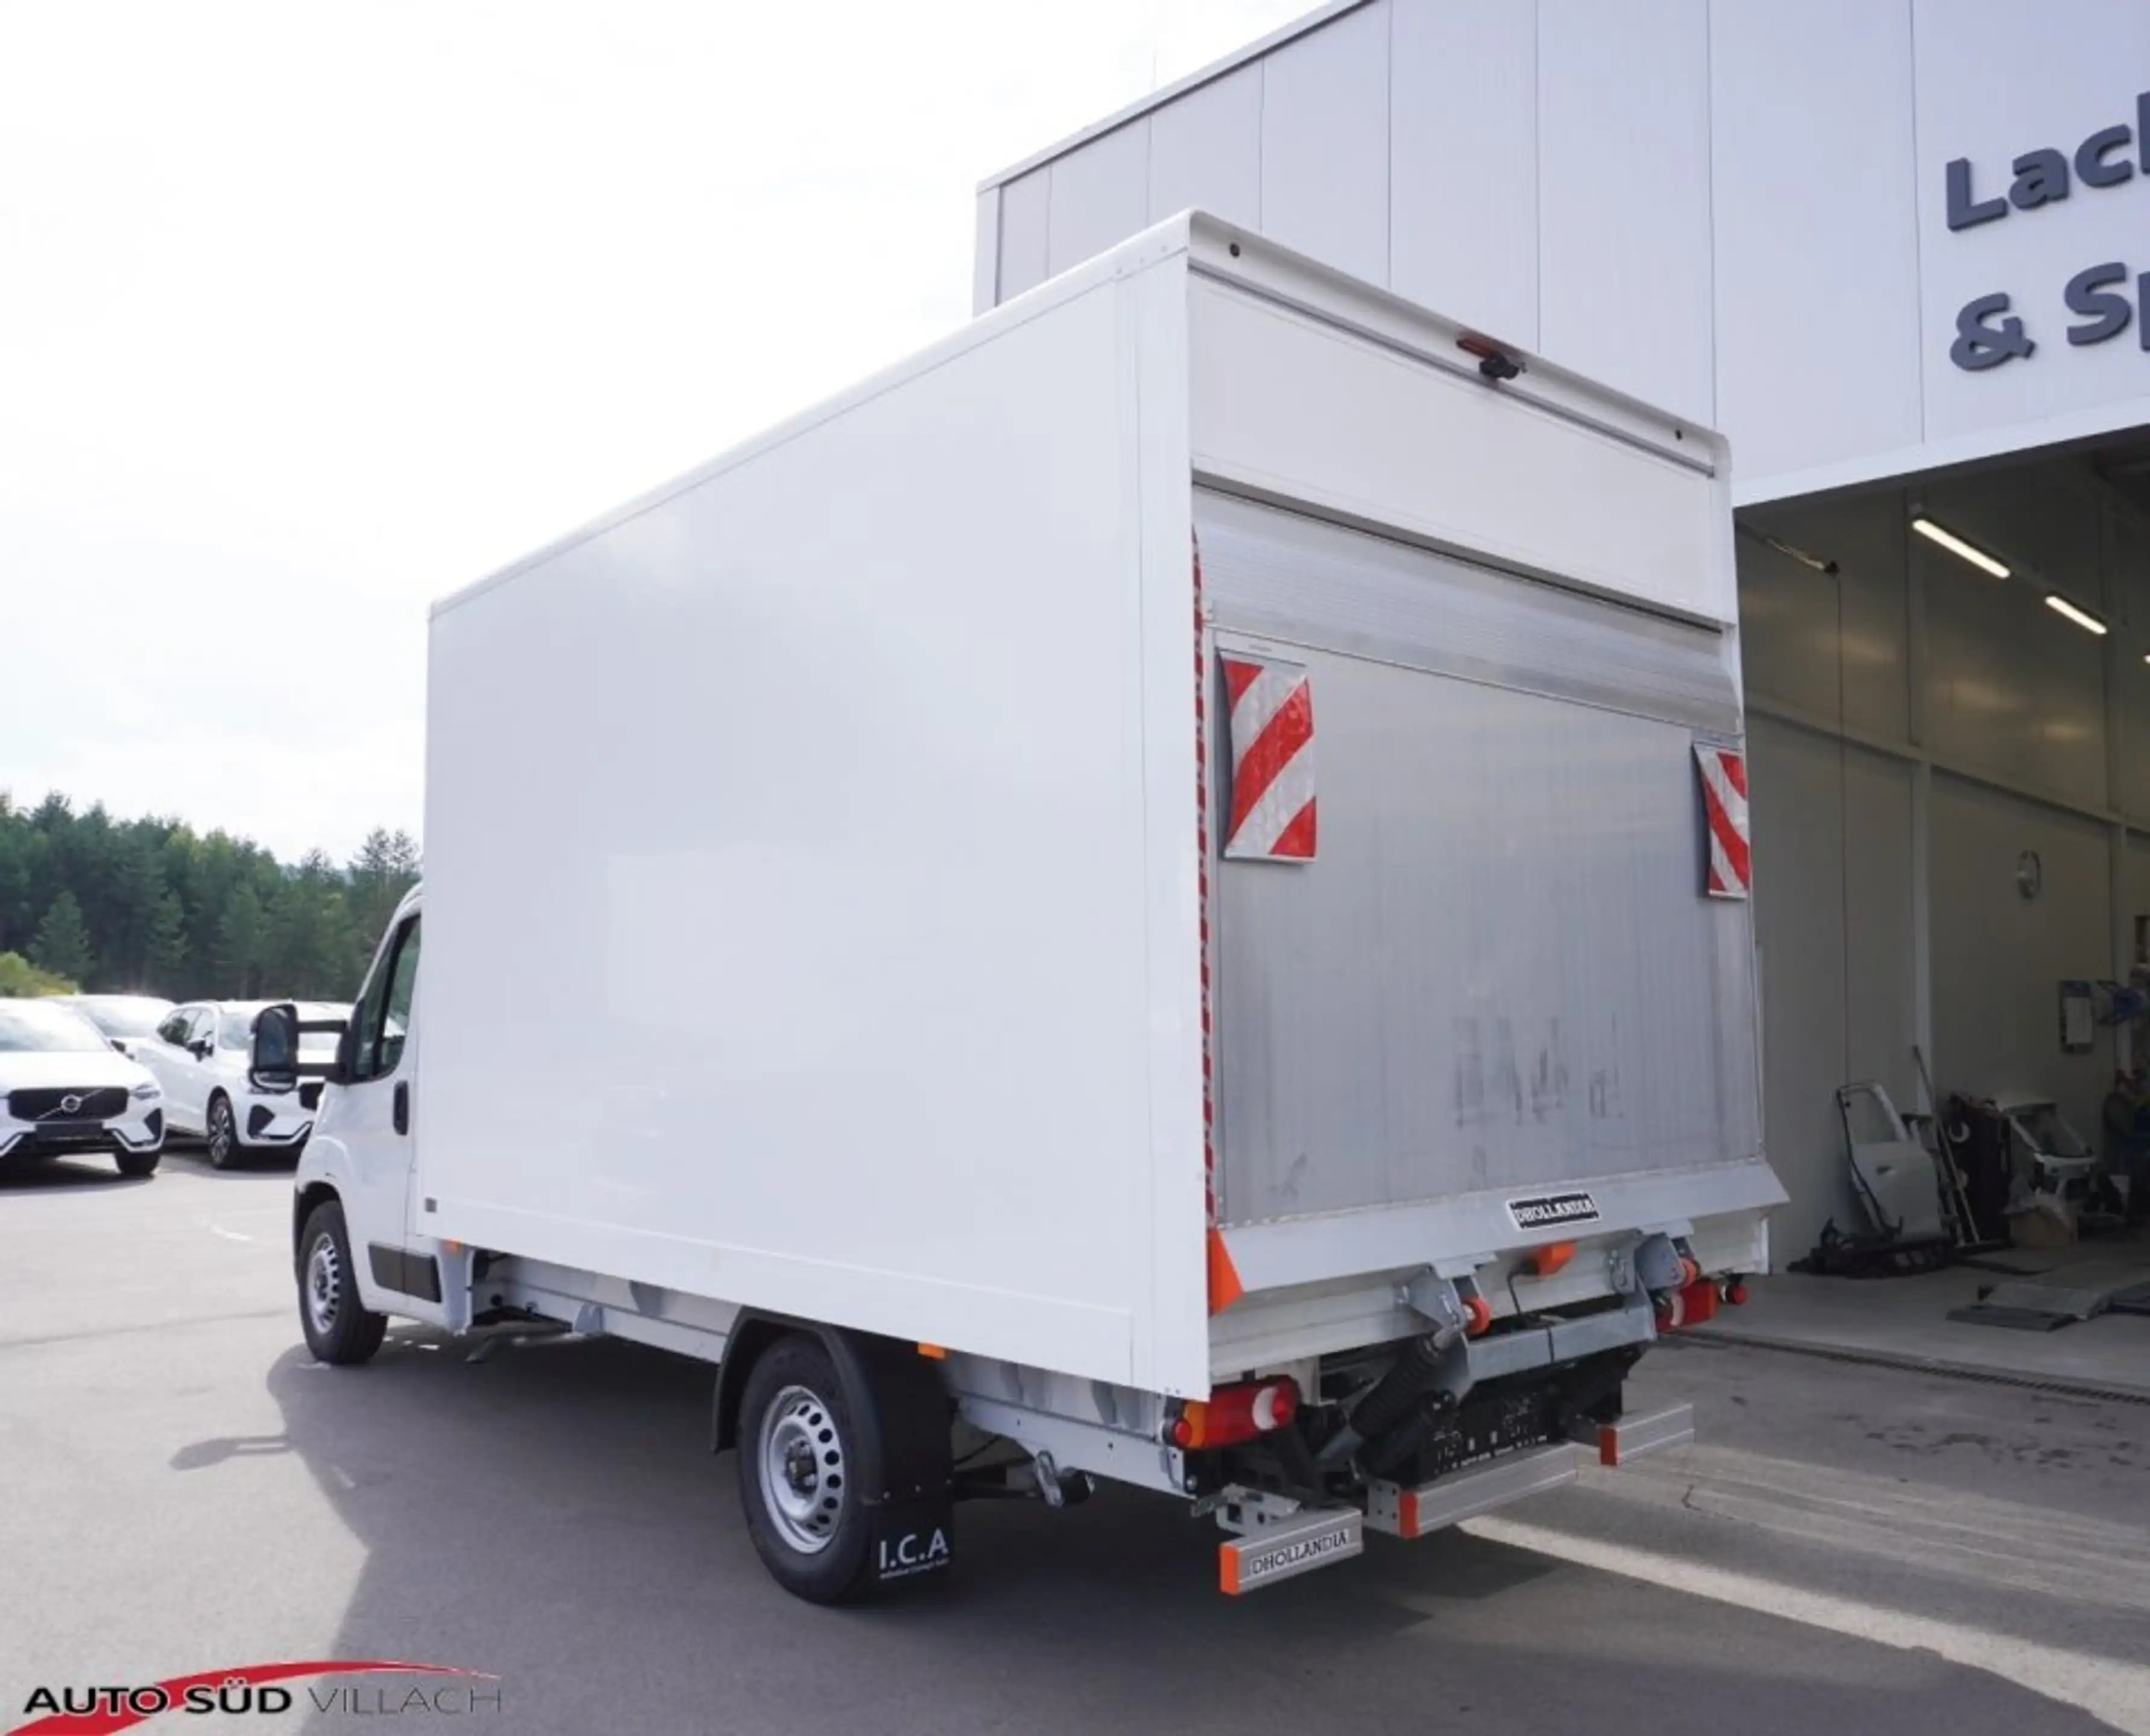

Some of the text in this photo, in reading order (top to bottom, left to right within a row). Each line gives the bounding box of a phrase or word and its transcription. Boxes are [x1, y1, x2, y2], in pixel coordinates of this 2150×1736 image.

[1950, 292, 2035, 372] &
[880, 1527, 948, 1570] I.C.A
[1252, 1531, 1347, 1574] DHOLLANDIA
